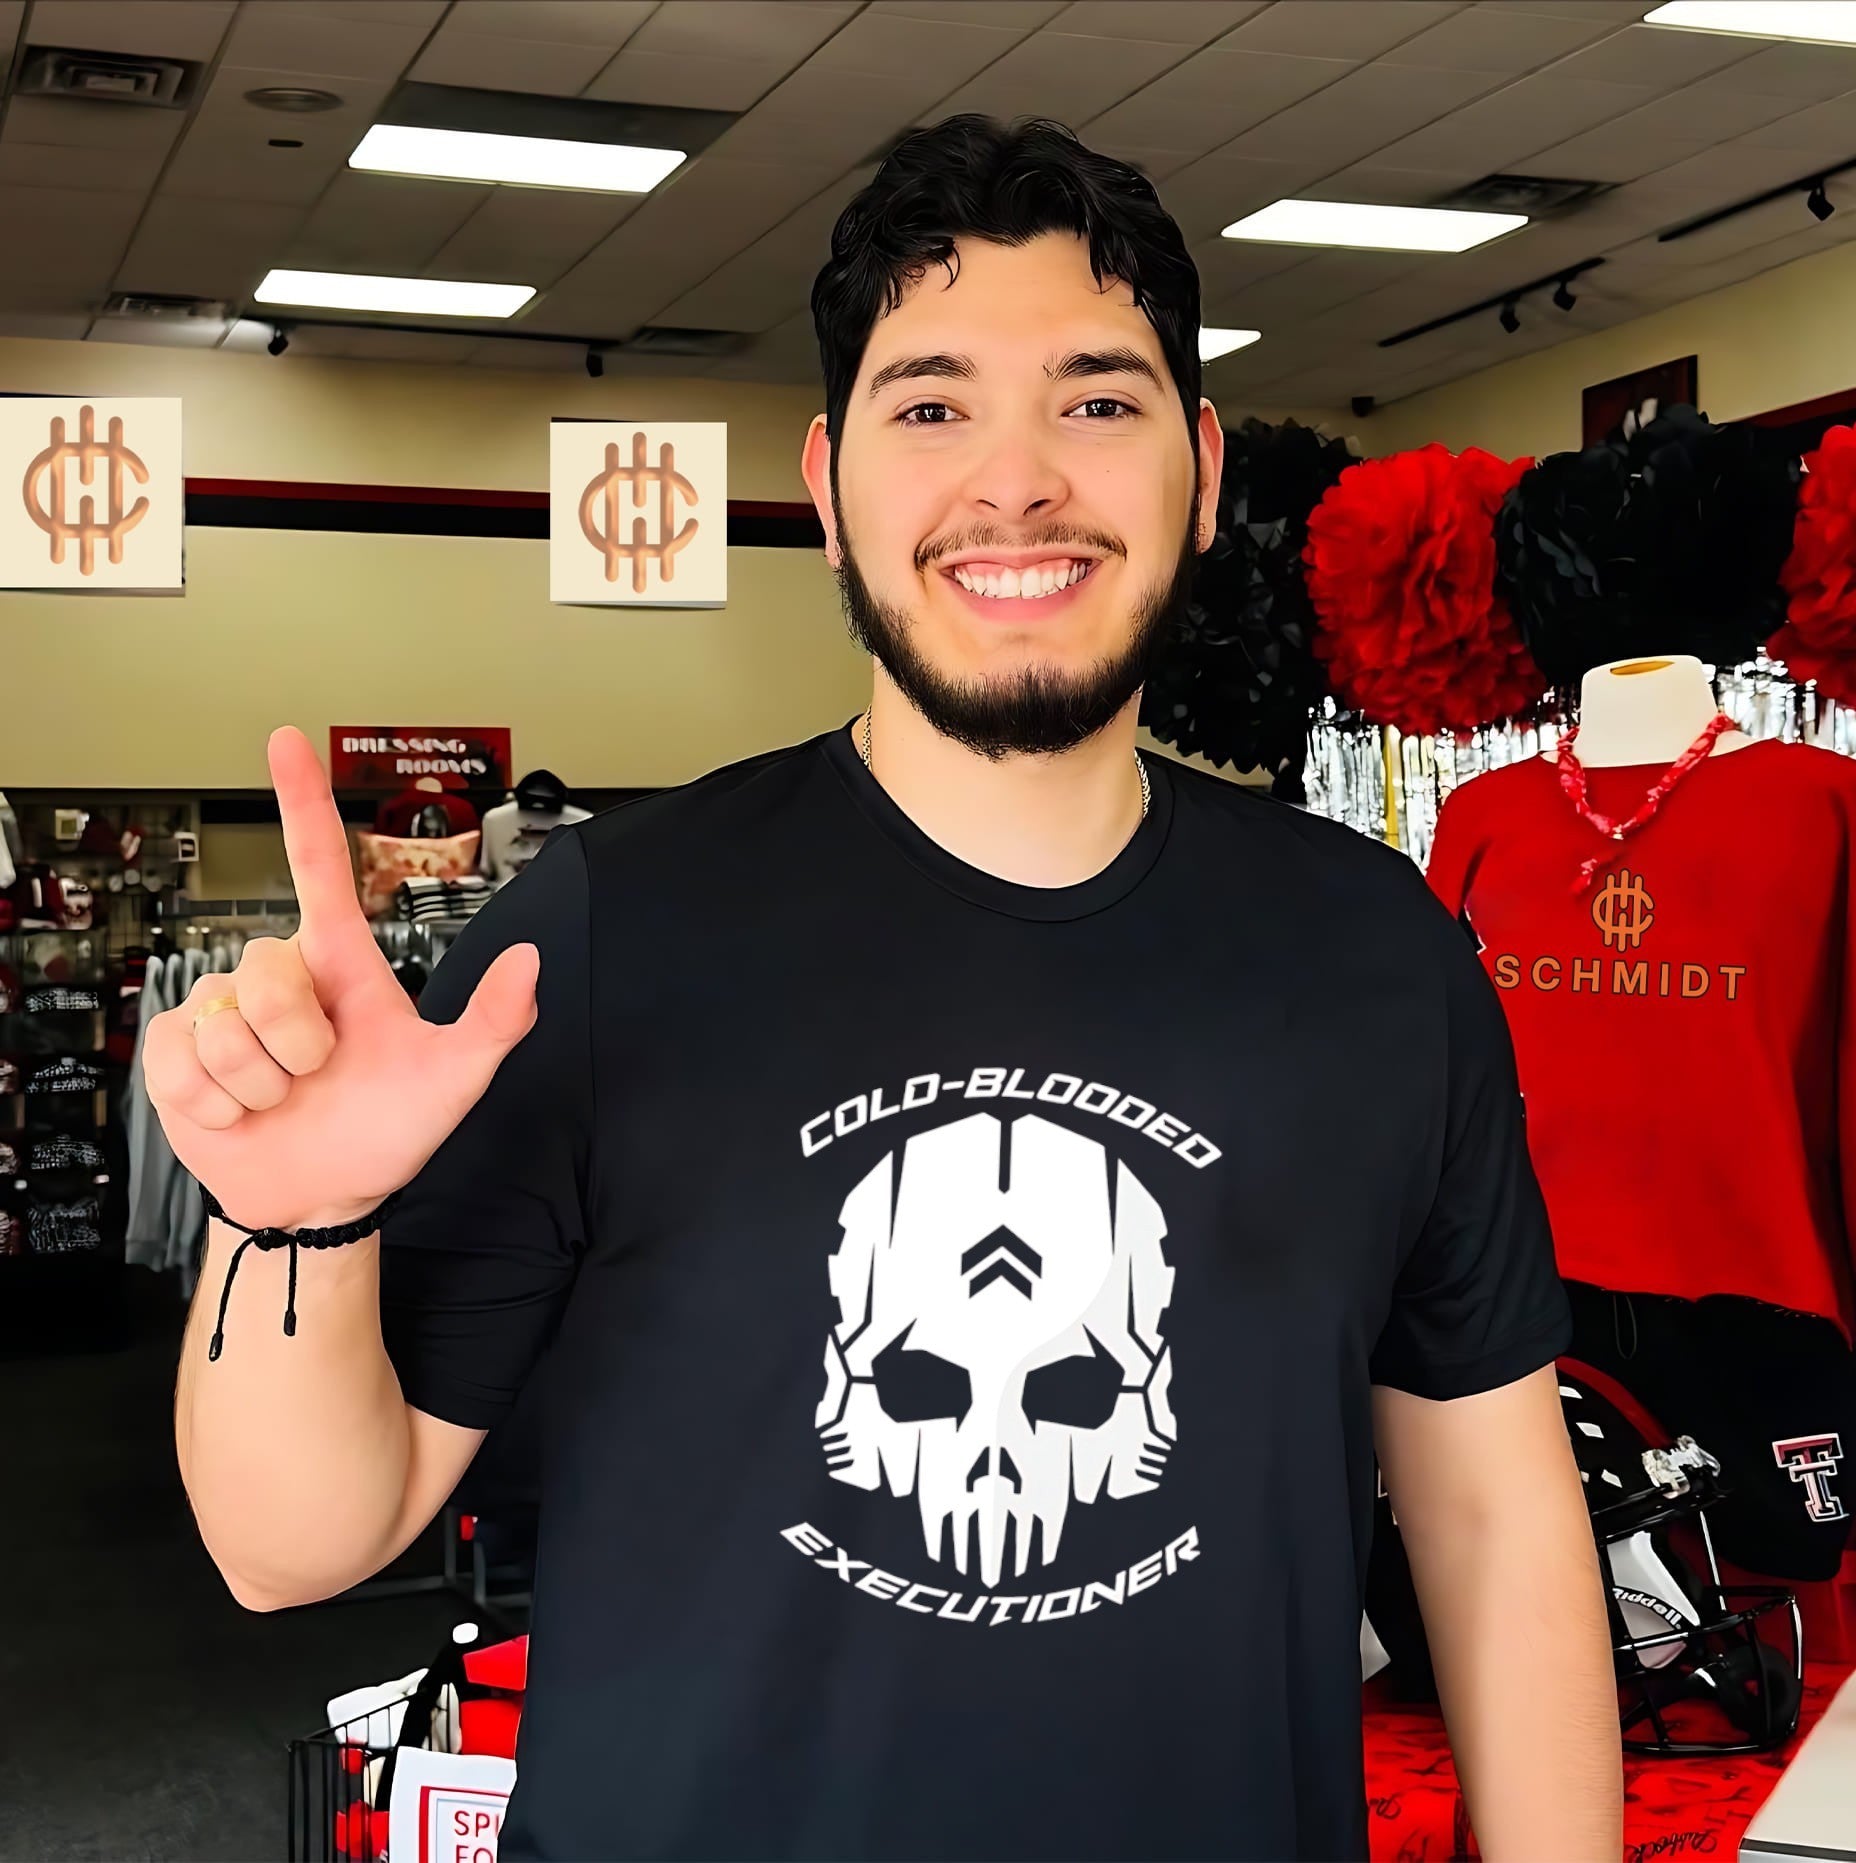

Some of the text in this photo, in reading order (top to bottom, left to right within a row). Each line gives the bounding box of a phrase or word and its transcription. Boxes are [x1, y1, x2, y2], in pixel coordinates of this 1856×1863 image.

[342, 737, 467, 754] DRESSING
[396, 758, 487, 775] ROOMS
[1494, 954, 1747, 1001] SCHMIDT
[800, 1067, 1223, 1170] COLD-BLOODED
[780, 1521, 1201, 1627] EXECUTIONER
